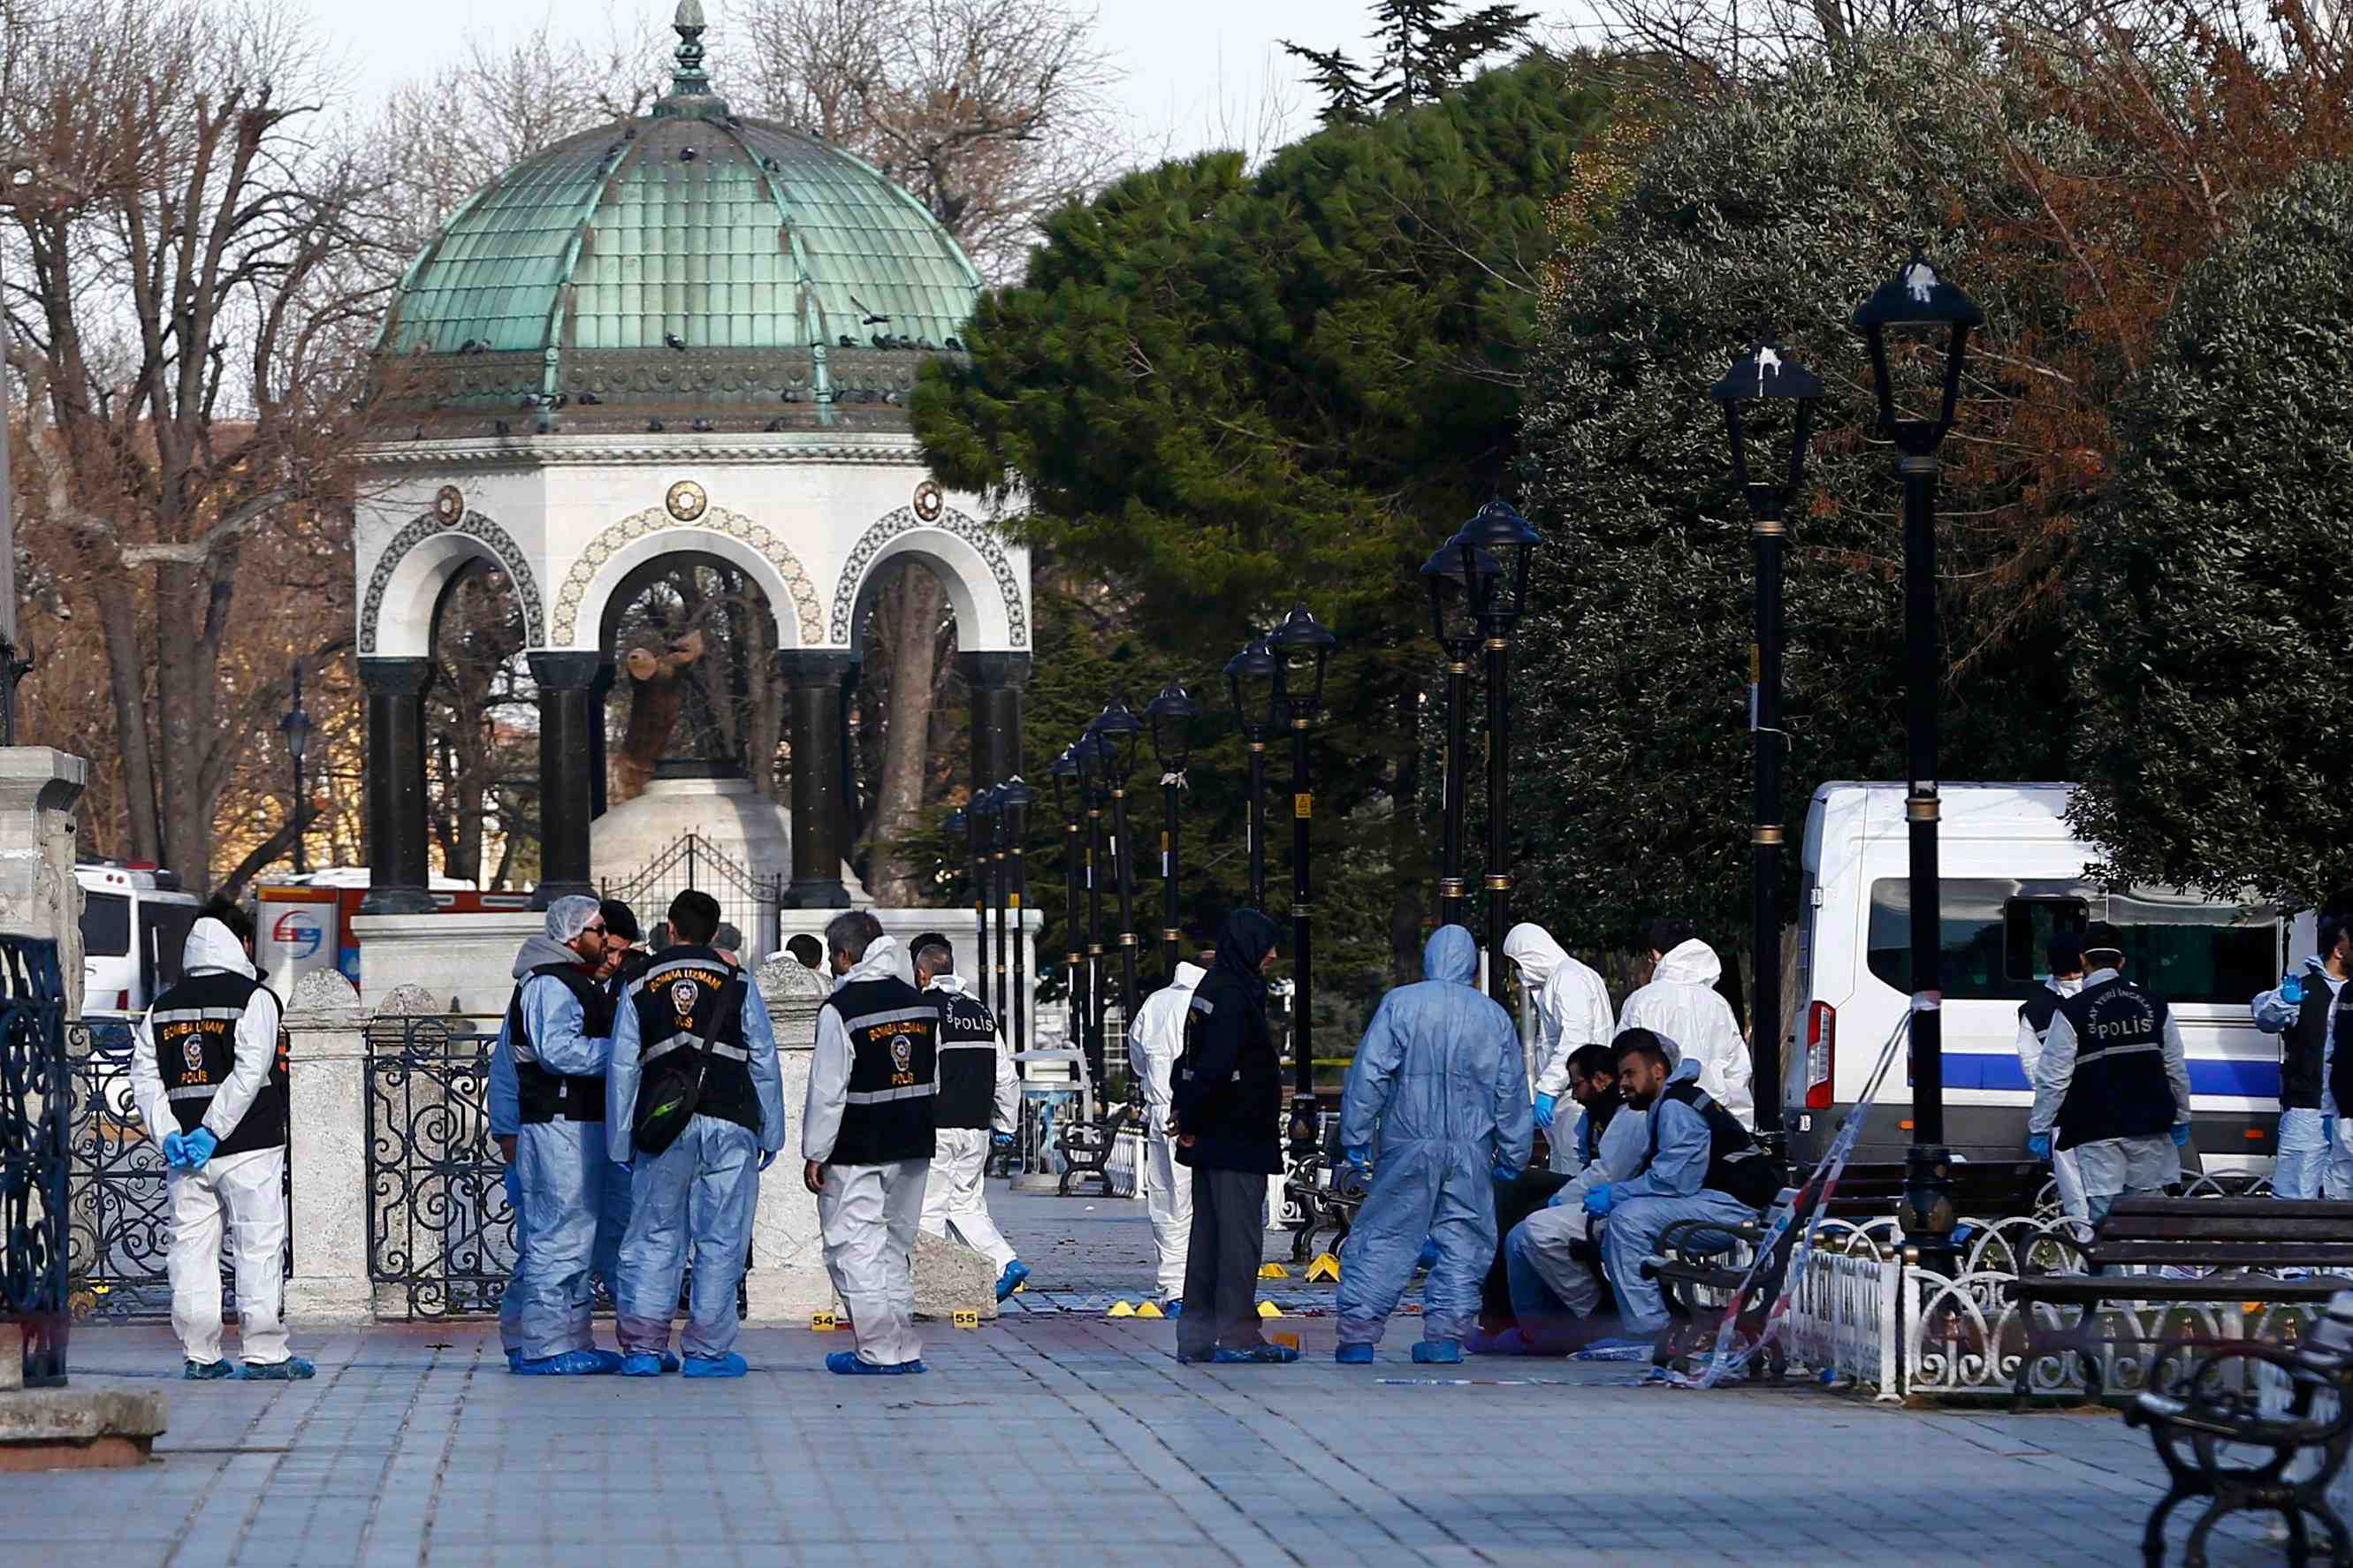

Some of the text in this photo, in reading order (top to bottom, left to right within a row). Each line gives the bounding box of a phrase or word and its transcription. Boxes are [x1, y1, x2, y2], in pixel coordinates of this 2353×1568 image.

[954, 1014, 994, 1032] POLİS
[2098, 1016, 2151, 1039] POLİS
[812, 1315, 834, 1326] 54
[955, 1313, 976, 1323] 55
